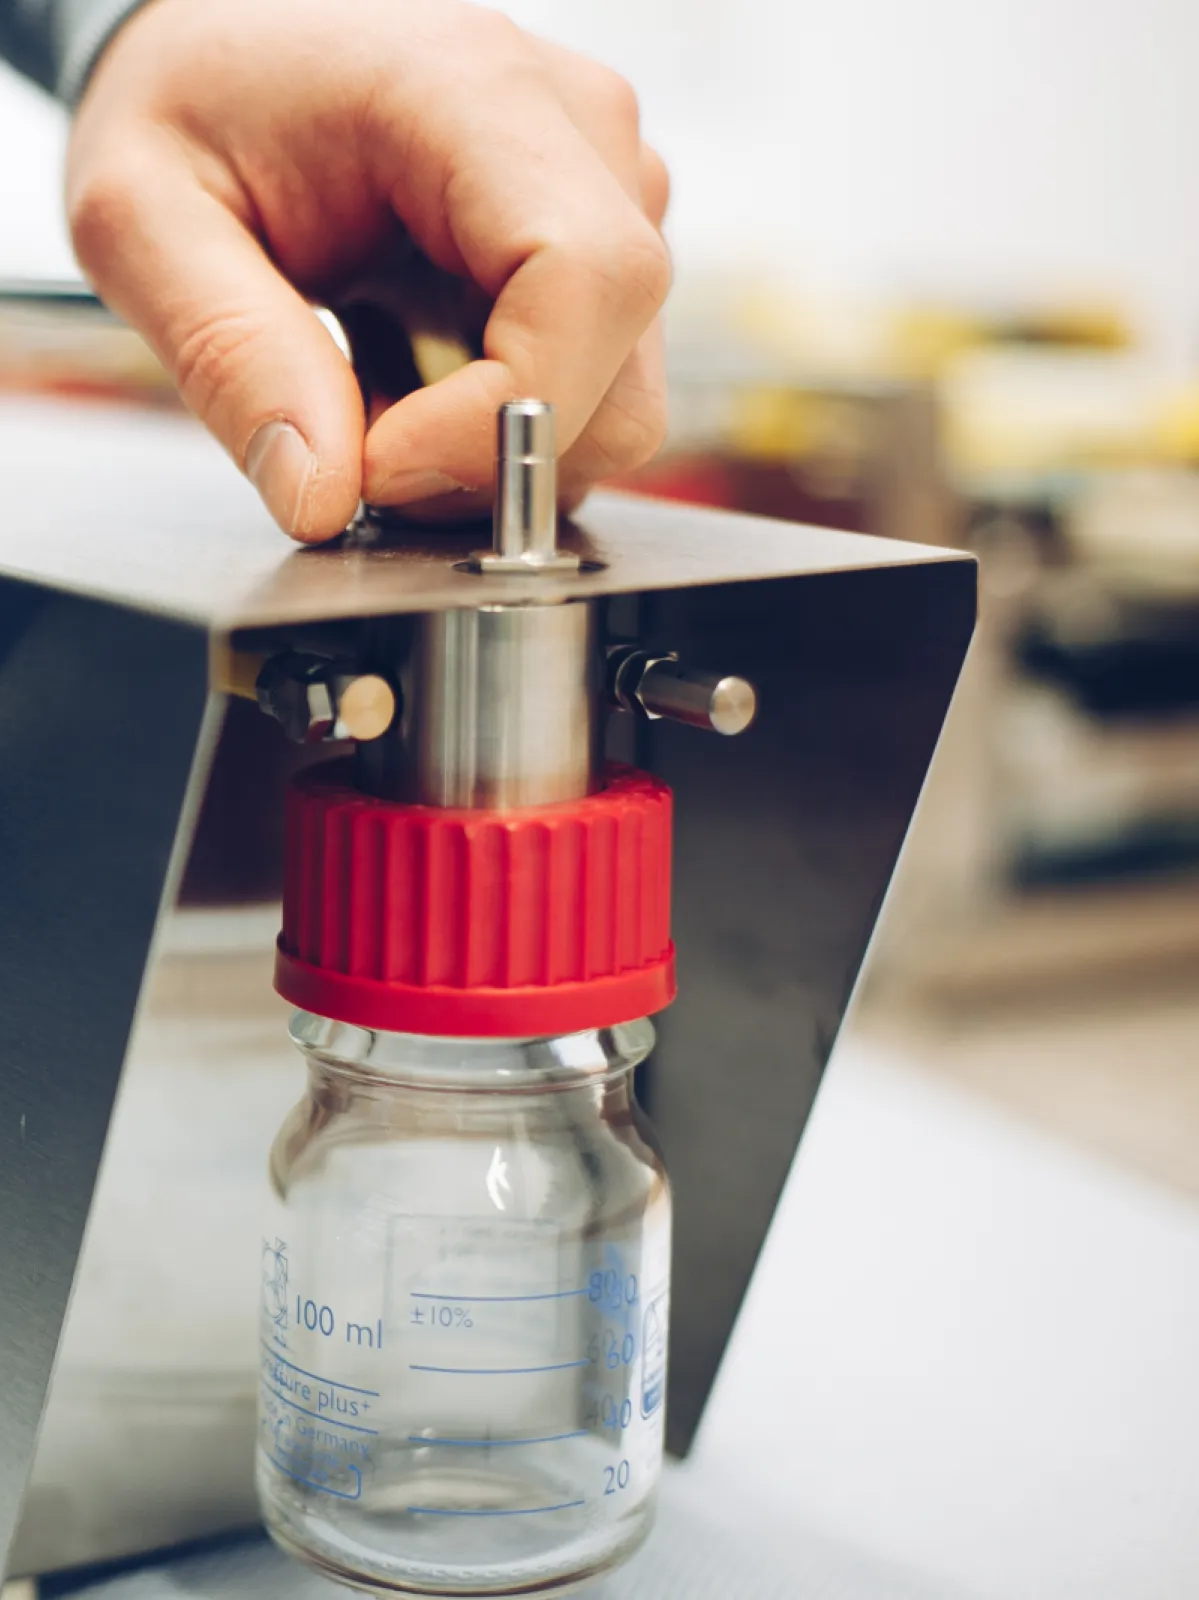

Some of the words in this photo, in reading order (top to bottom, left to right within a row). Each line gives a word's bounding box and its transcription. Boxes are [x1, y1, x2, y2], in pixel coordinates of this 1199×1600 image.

[296, 1294, 334, 1336] 100
[346, 1319, 382, 1349] ml
[409, 1305, 474, 1328] ±10%
[607, 1333, 634, 1370] 60
[603, 1397, 632, 1431] 40
[296, 1416, 370, 1458] Germany
[603, 1459, 630, 1496] 20
